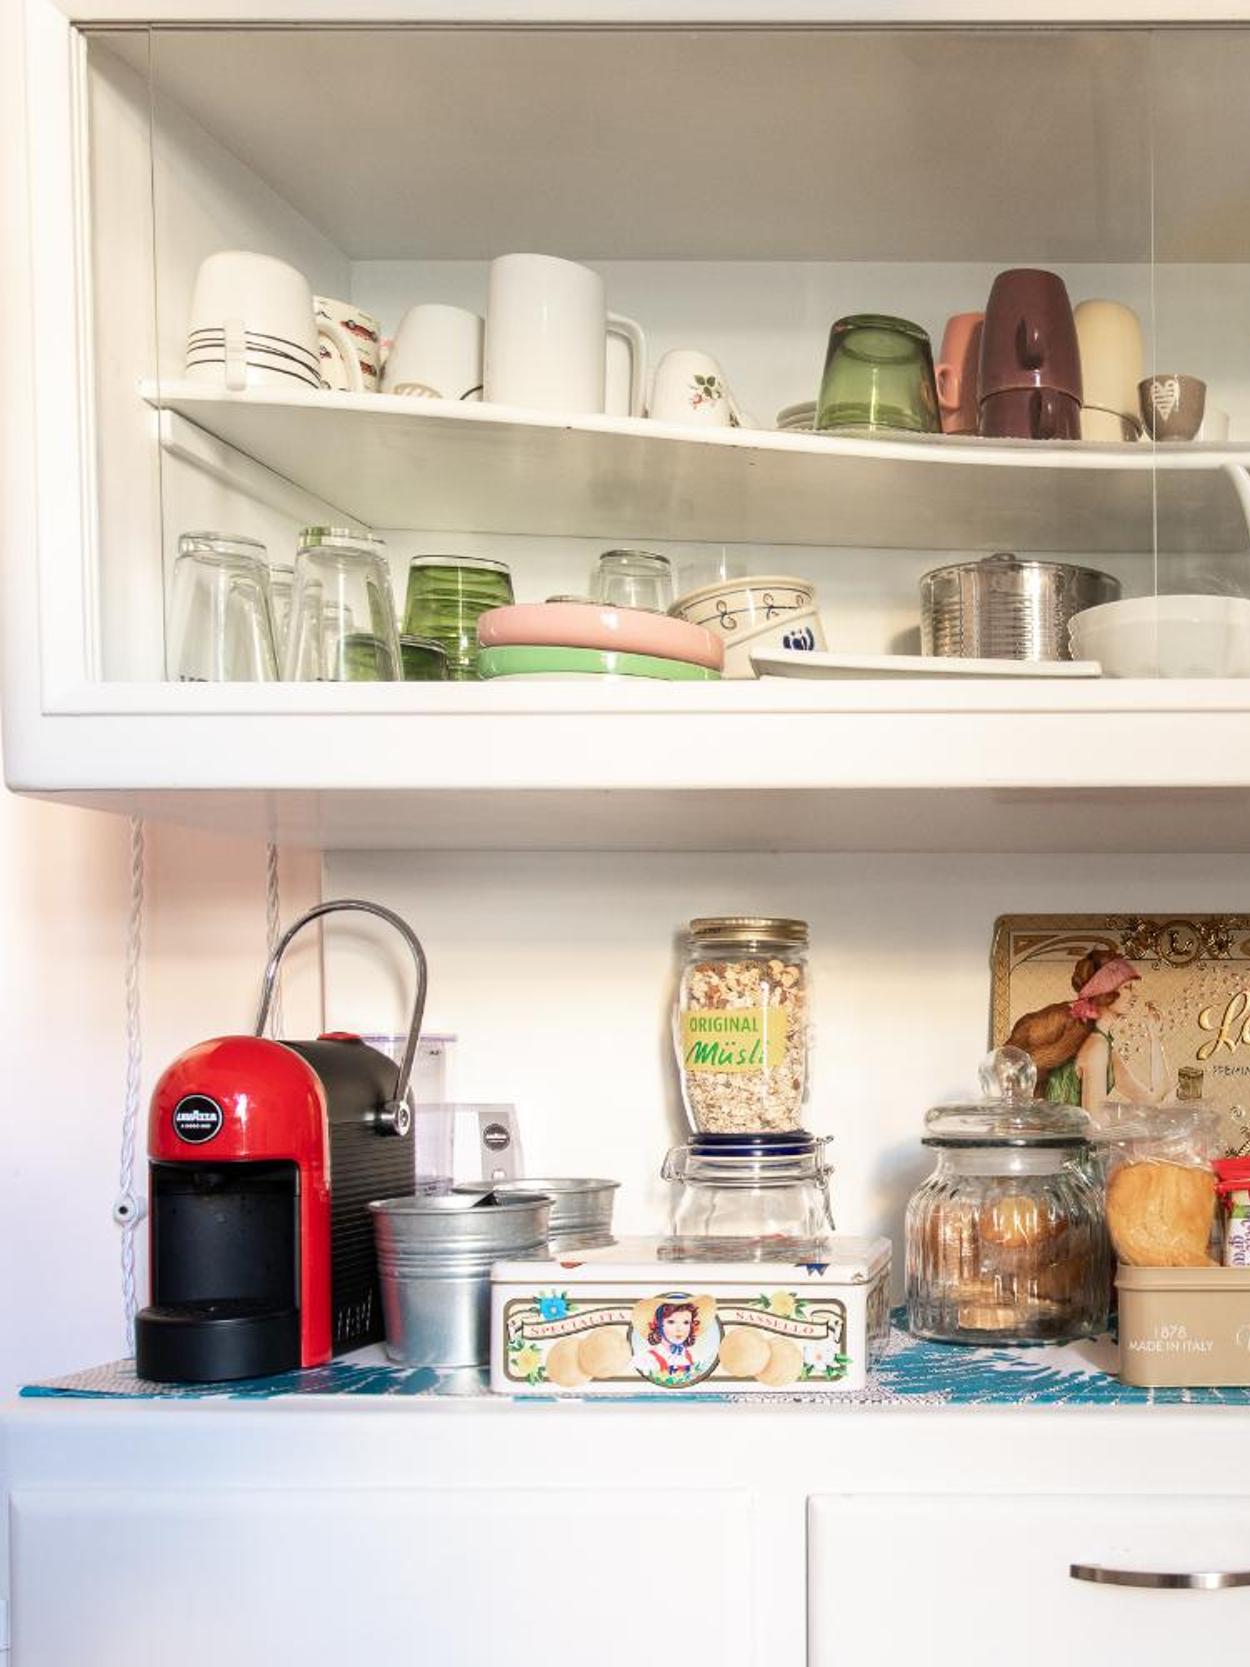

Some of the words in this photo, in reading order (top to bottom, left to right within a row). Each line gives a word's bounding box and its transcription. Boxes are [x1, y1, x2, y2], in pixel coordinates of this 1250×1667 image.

[688, 1016, 759, 1033] ORIGINAL
[1128, 1340, 1163, 1352] MADE
[1166, 1340, 1180, 1352] IN
[1181, 1340, 1214, 1352] ITALY
